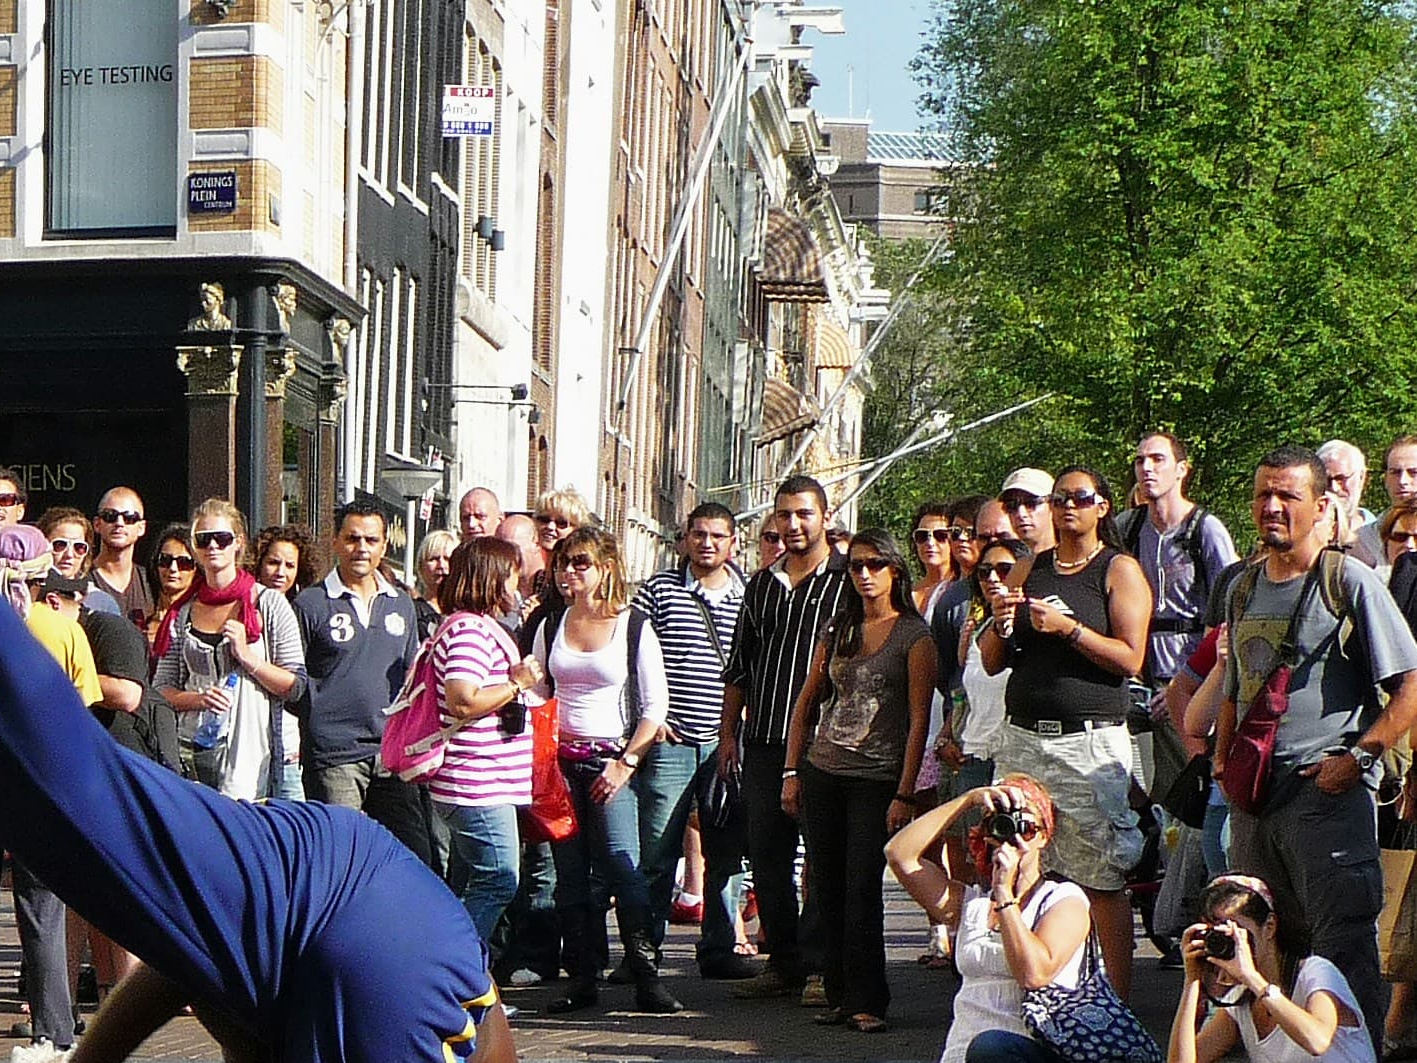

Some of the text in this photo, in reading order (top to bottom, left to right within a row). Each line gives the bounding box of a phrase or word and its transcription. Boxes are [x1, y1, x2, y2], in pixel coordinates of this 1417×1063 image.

[61, 64, 172, 86] EYE TESTING
[190, 176, 233, 189] KONINGS
[190, 190, 217, 202] PLEIN
[329, 613, 355, 642] 3
